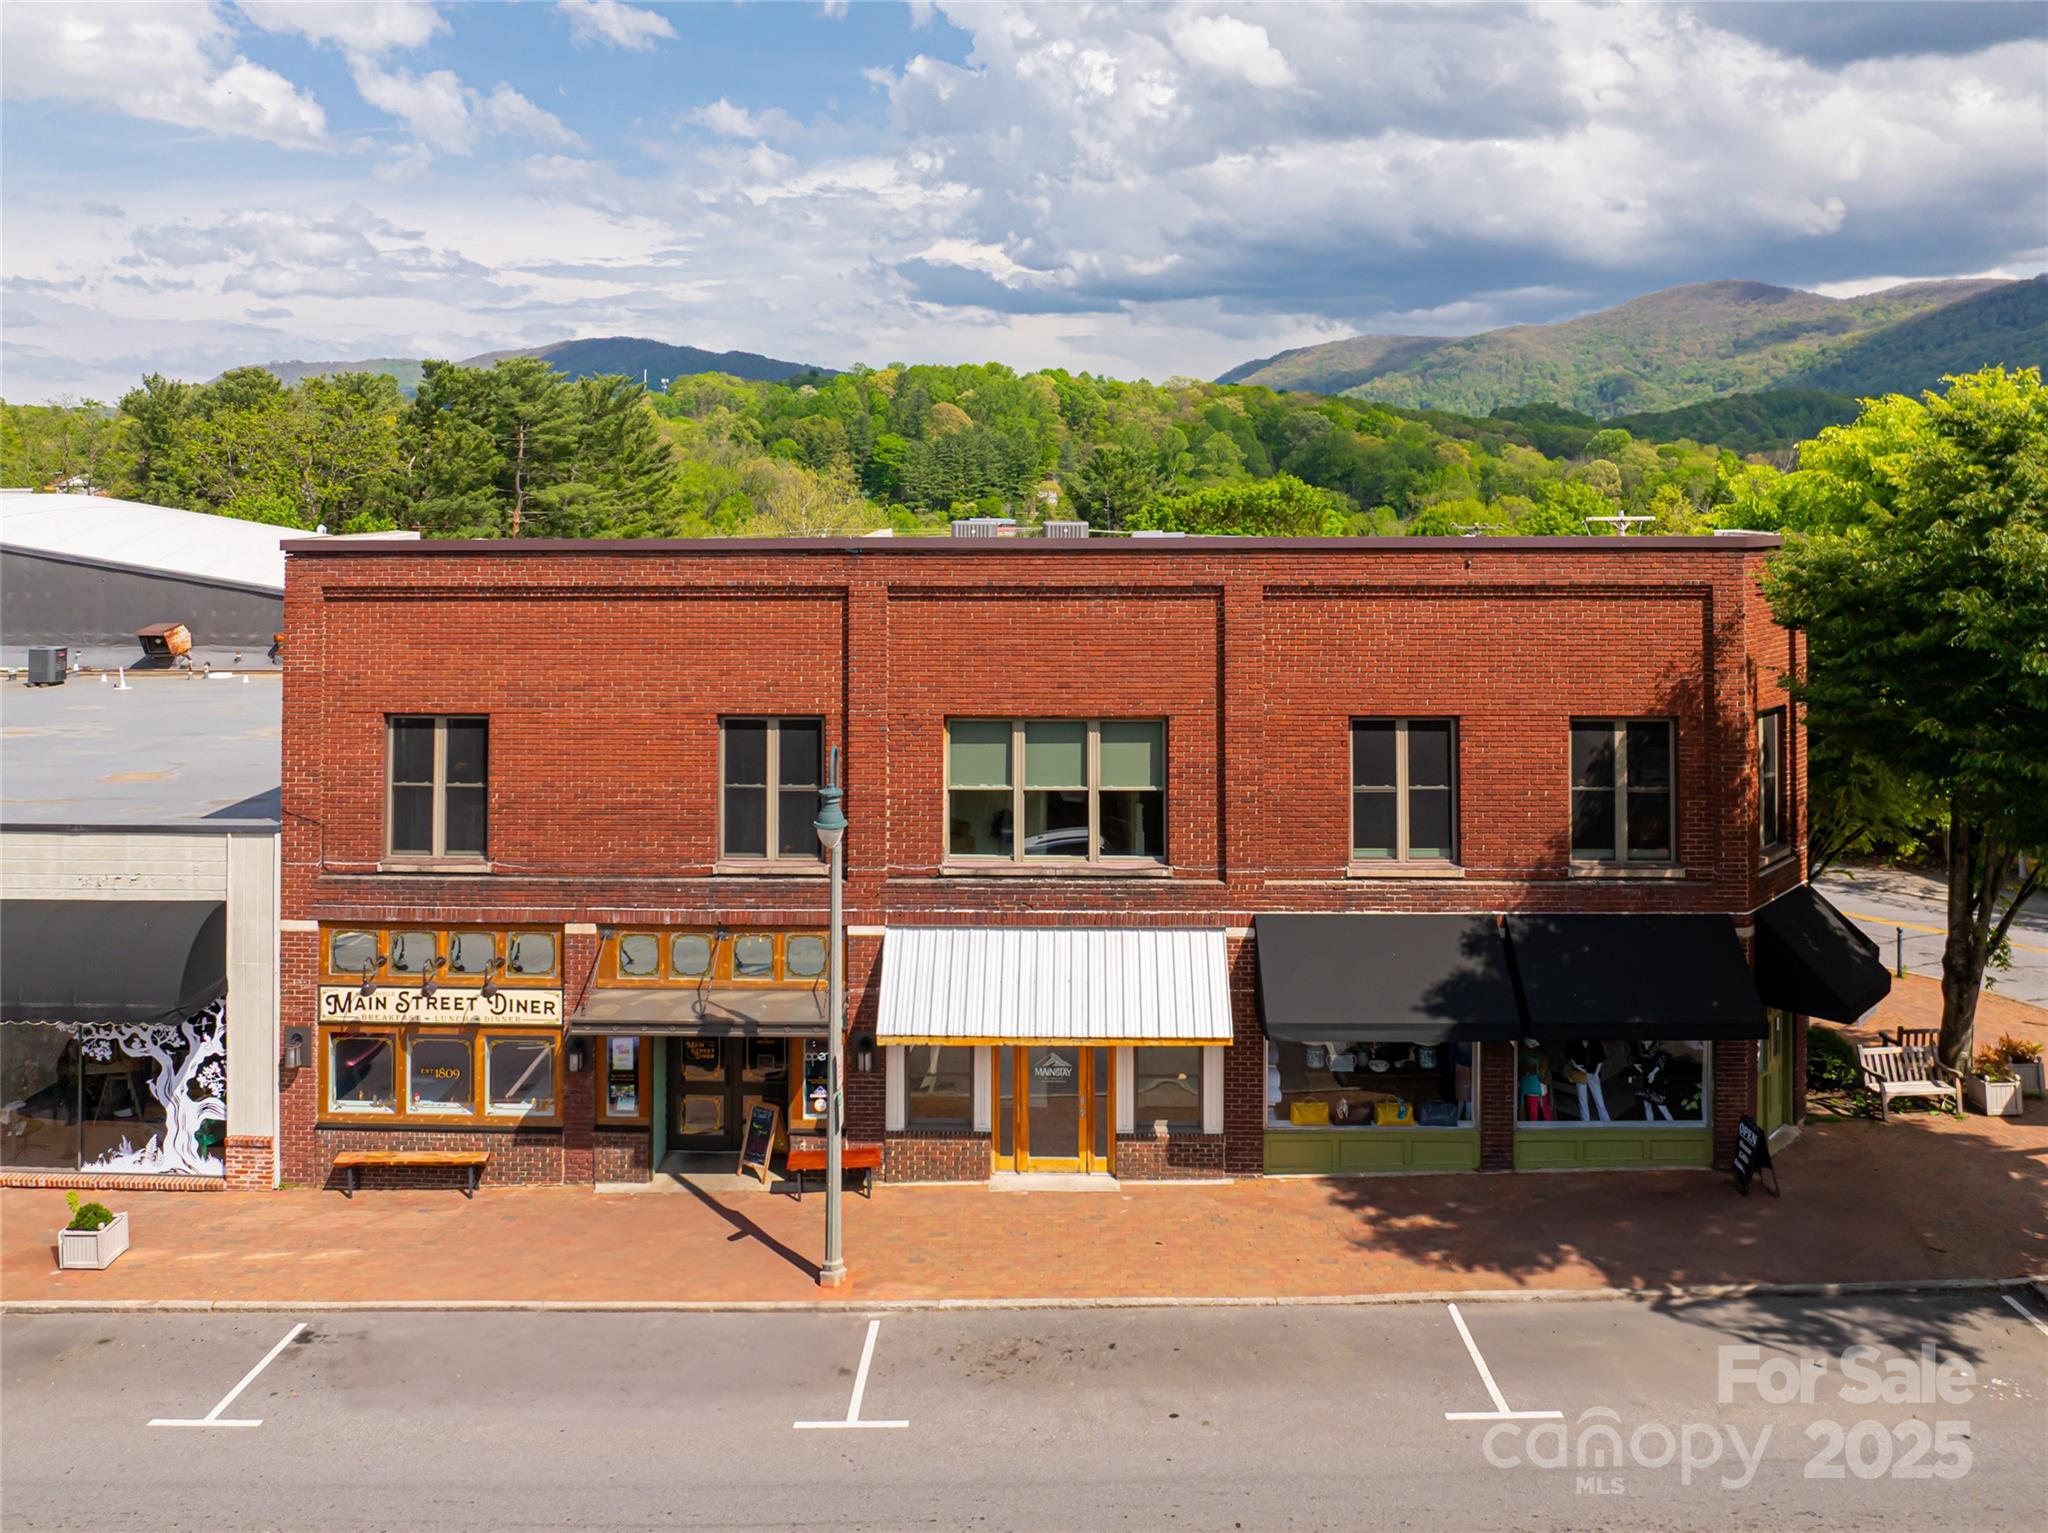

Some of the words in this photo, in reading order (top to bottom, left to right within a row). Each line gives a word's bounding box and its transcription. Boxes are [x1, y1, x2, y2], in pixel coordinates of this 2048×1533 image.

[361, 1014, 420, 1022] BREAKFAST
[434, 1015, 468, 1023] LUNCH
[484, 1015, 521, 1024] DINNER
[435, 1066, 461, 1080] 1809
[1034, 1066, 1073, 1077] MAINSTAY
[1739, 1122, 1758, 1145] OPEN
